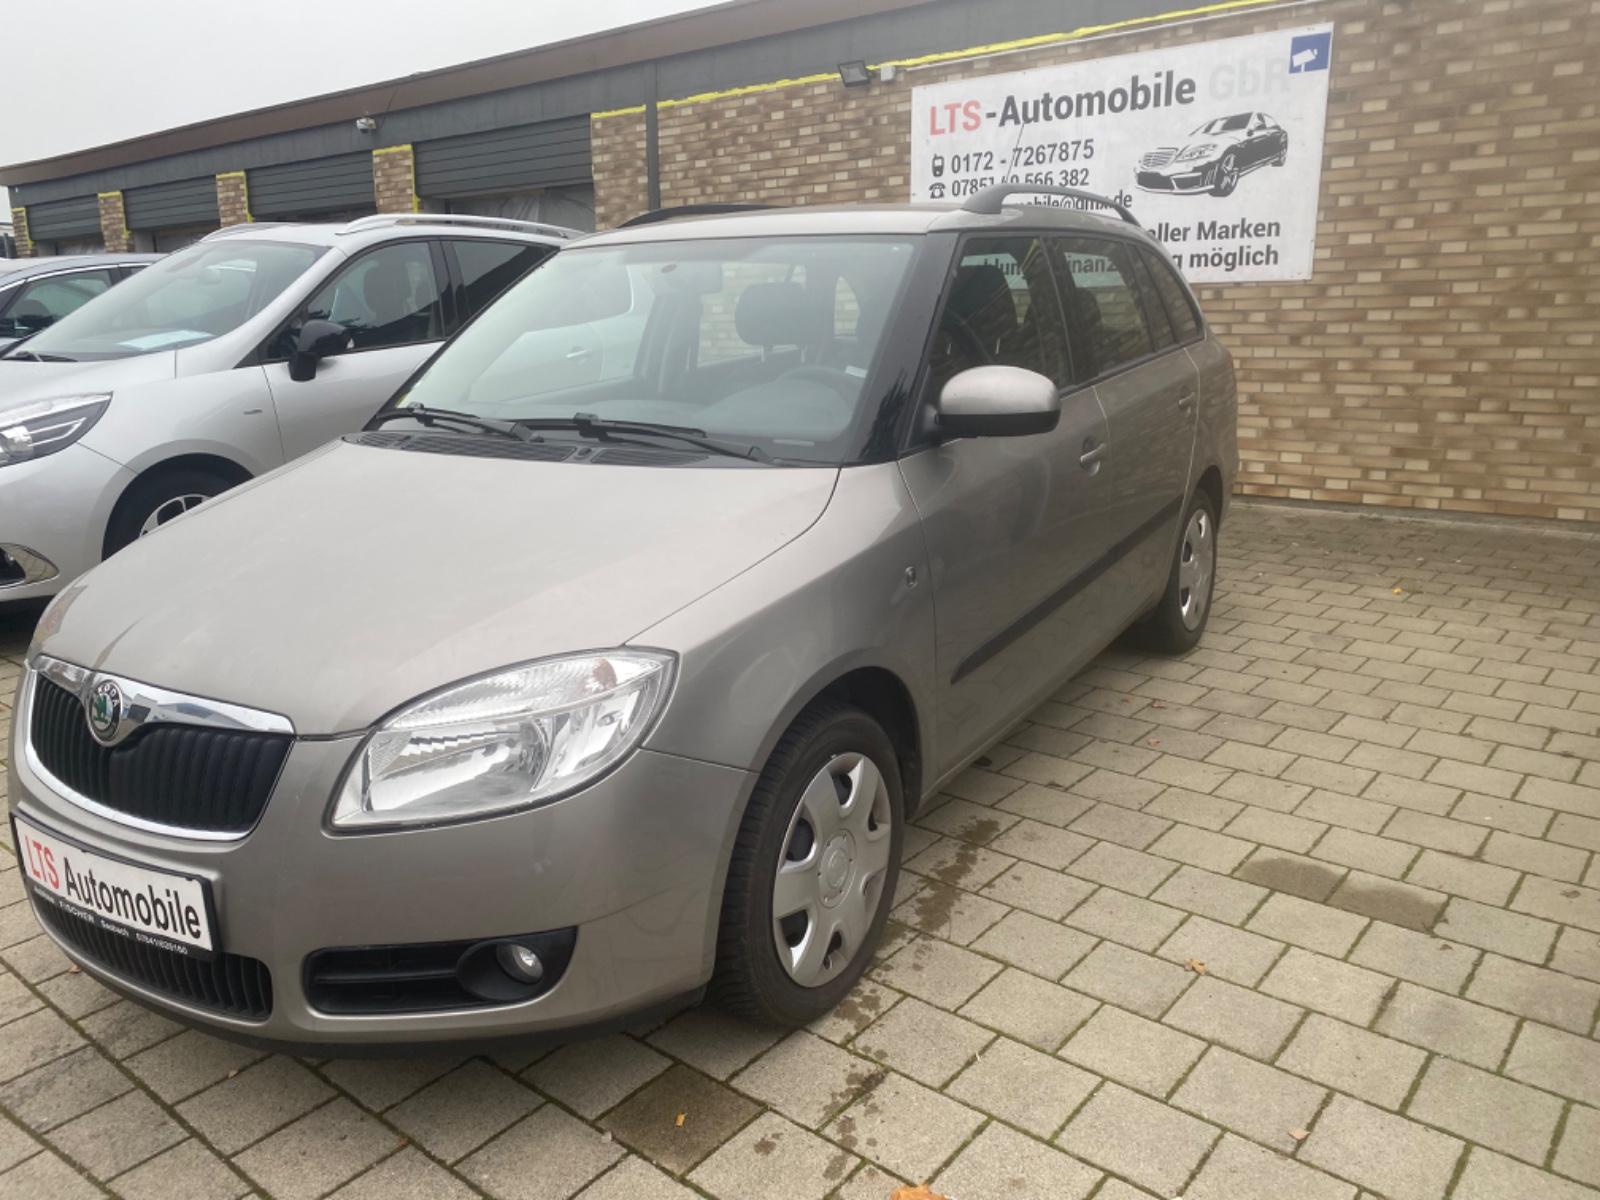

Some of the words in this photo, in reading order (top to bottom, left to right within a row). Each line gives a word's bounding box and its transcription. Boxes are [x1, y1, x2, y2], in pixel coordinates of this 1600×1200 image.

[951, 150, 994, 174] 0172
[1012, 138, 1095, 168] 7267875
[1058, 168, 1090, 188] 382
[1196, 217, 1281, 242] Marken
[1188, 245, 1279, 271] möglich
[25, 835, 60, 890] LTS
[64, 856, 202, 940] Automobile
